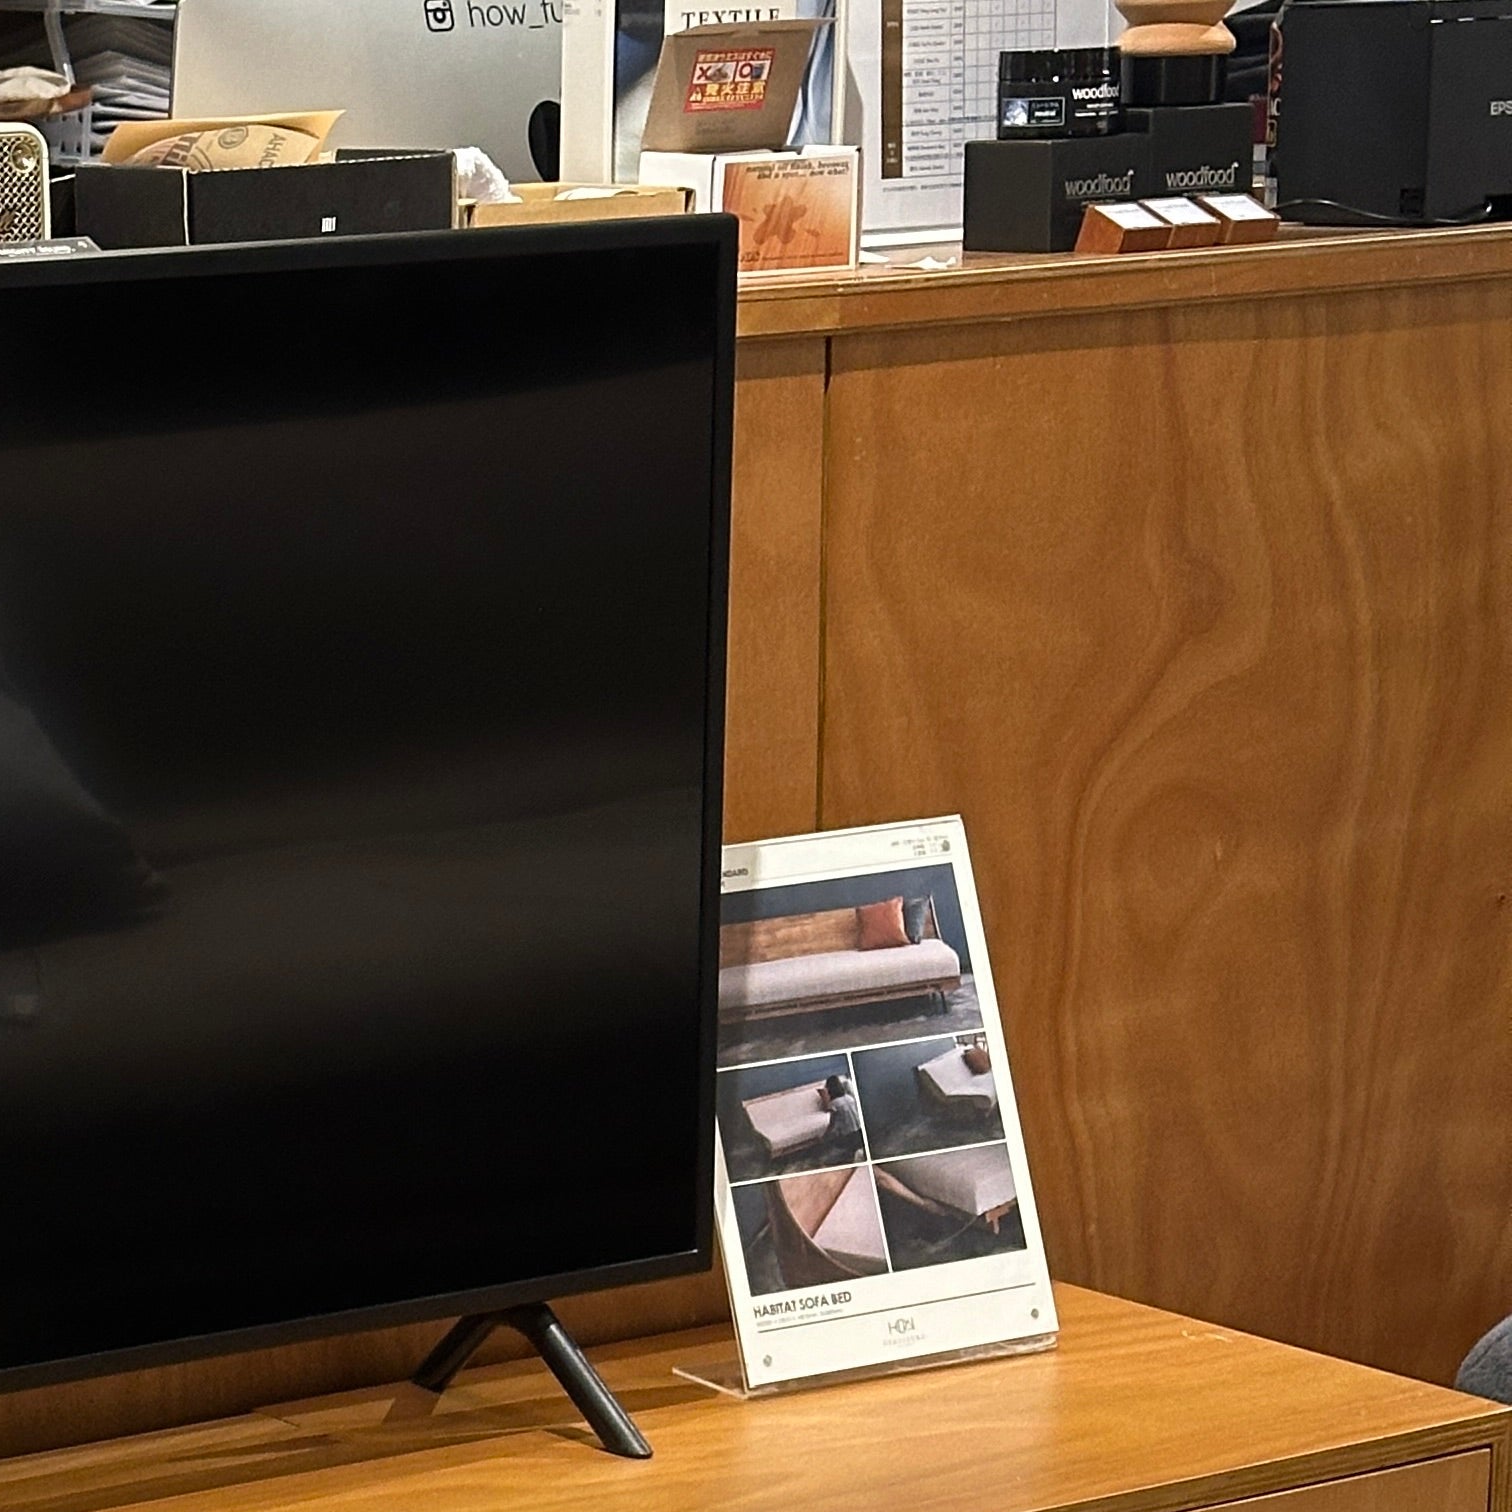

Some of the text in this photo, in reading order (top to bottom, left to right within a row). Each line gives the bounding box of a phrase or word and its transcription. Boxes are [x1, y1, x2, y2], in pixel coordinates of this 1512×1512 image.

[1065, 170, 1135, 197] woodfood
[1166, 162, 1240, 189] woodfood
[753, 1299, 797, 1319] HABITAT
[799, 1295, 829, 1312] SOFA
[831, 1291, 853, 1305] BED
